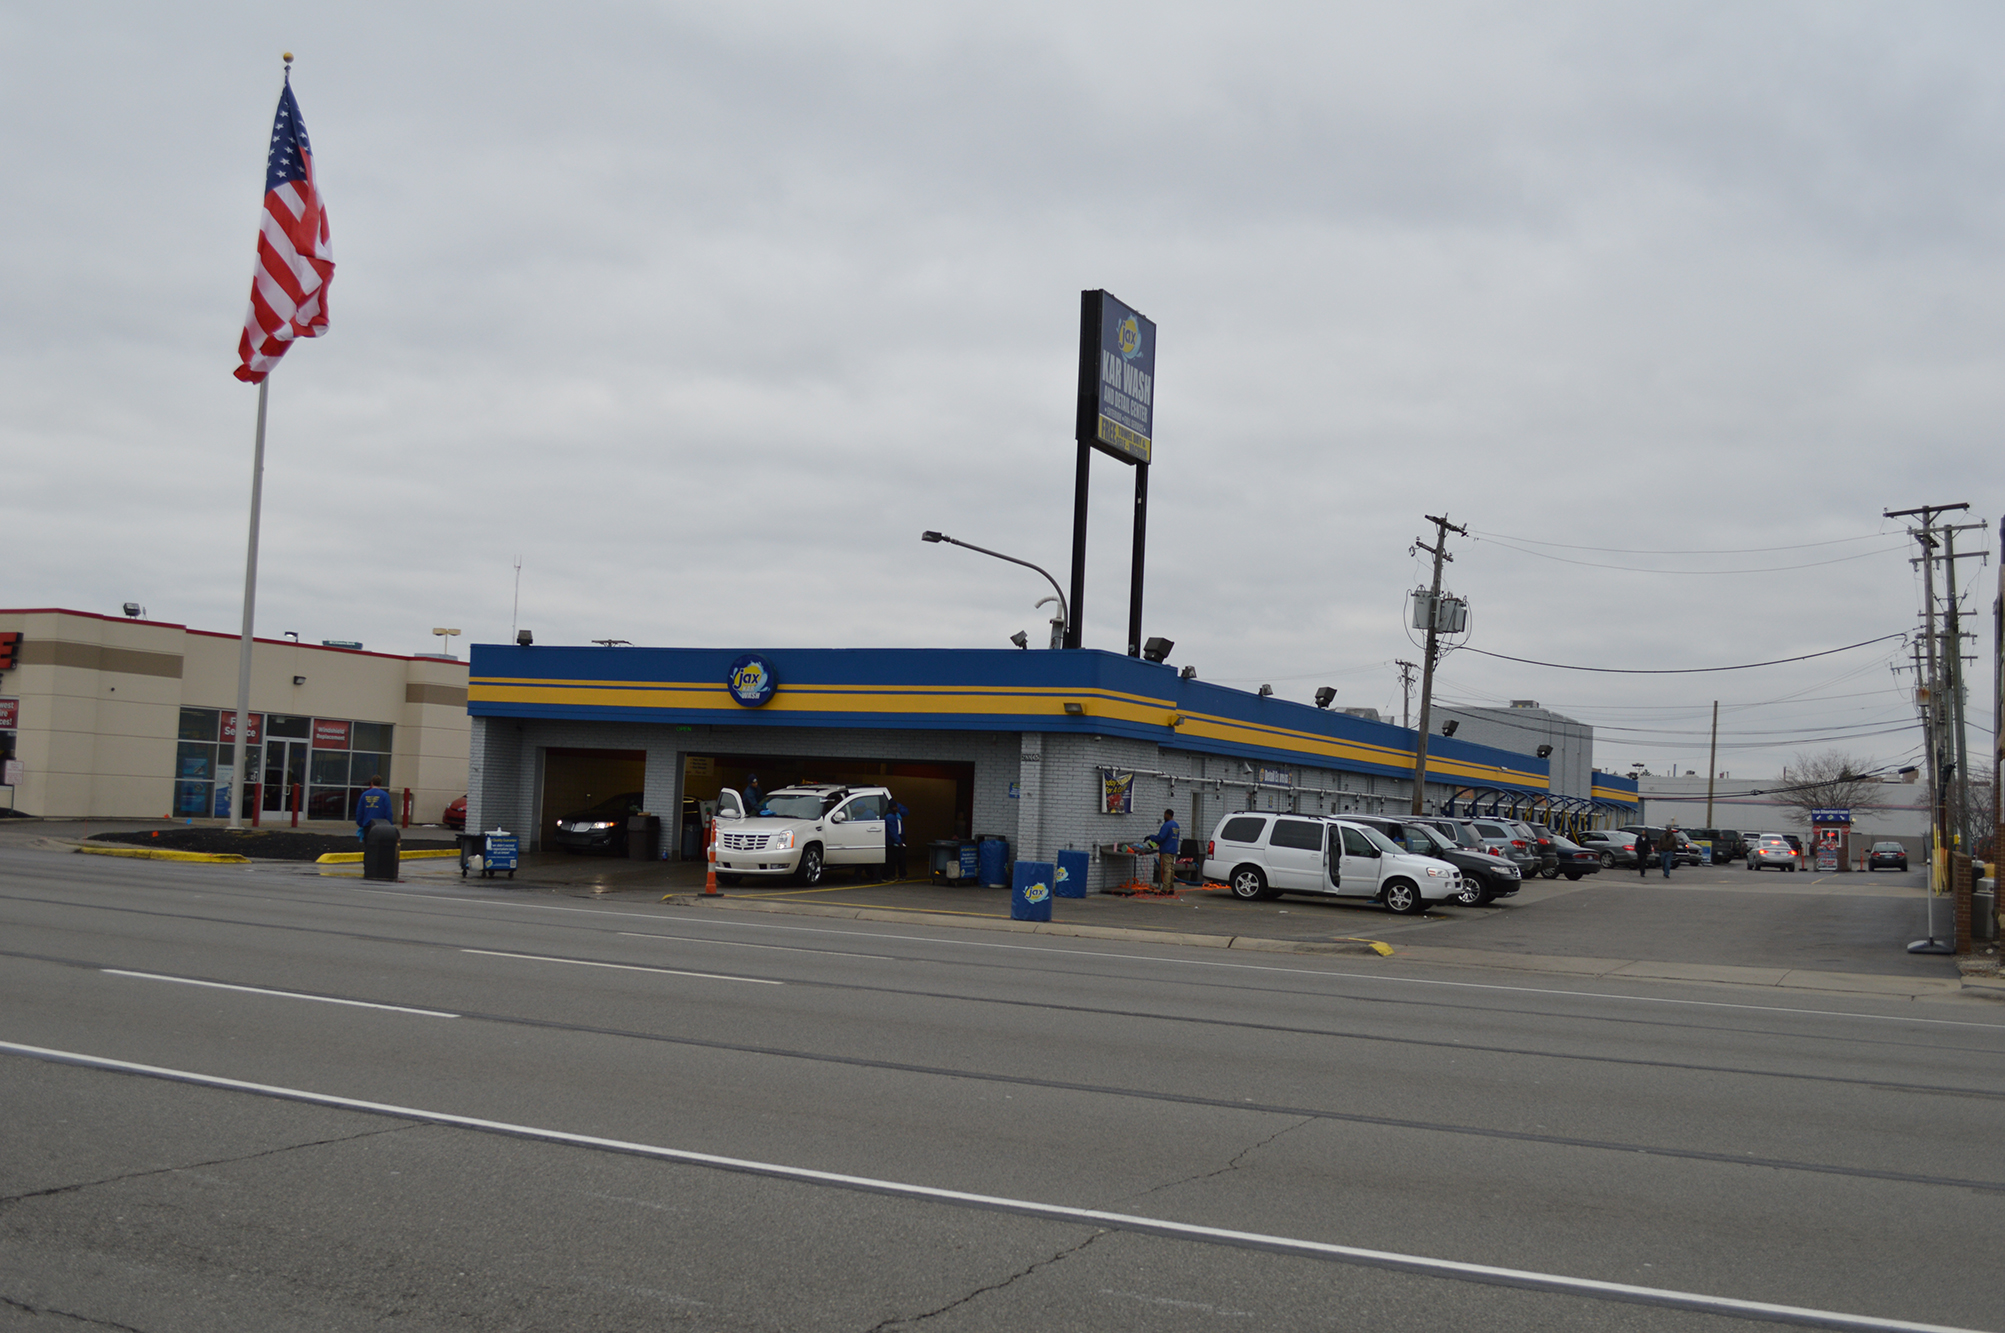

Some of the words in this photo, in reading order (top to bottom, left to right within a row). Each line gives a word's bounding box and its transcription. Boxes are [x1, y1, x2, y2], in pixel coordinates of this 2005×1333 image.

[1118, 320, 1137, 349] jax
[1102, 349, 1122, 390] KAR
[1123, 361, 1151, 406] WASH
[1103, 385, 1114, 405] AND
[1114, 391, 1130, 414] DETAIL
[1130, 399, 1148, 423] CENTER
[1101, 417, 1117, 445] FREE
[732, 668, 760, 689] jax
[230, 717, 252, 727] Ft
[224, 726, 256, 737] Sece
[316, 733, 345, 741] Replacement
[318, 726, 345, 735] Windshield
[1026, 887, 1043, 898] jax
